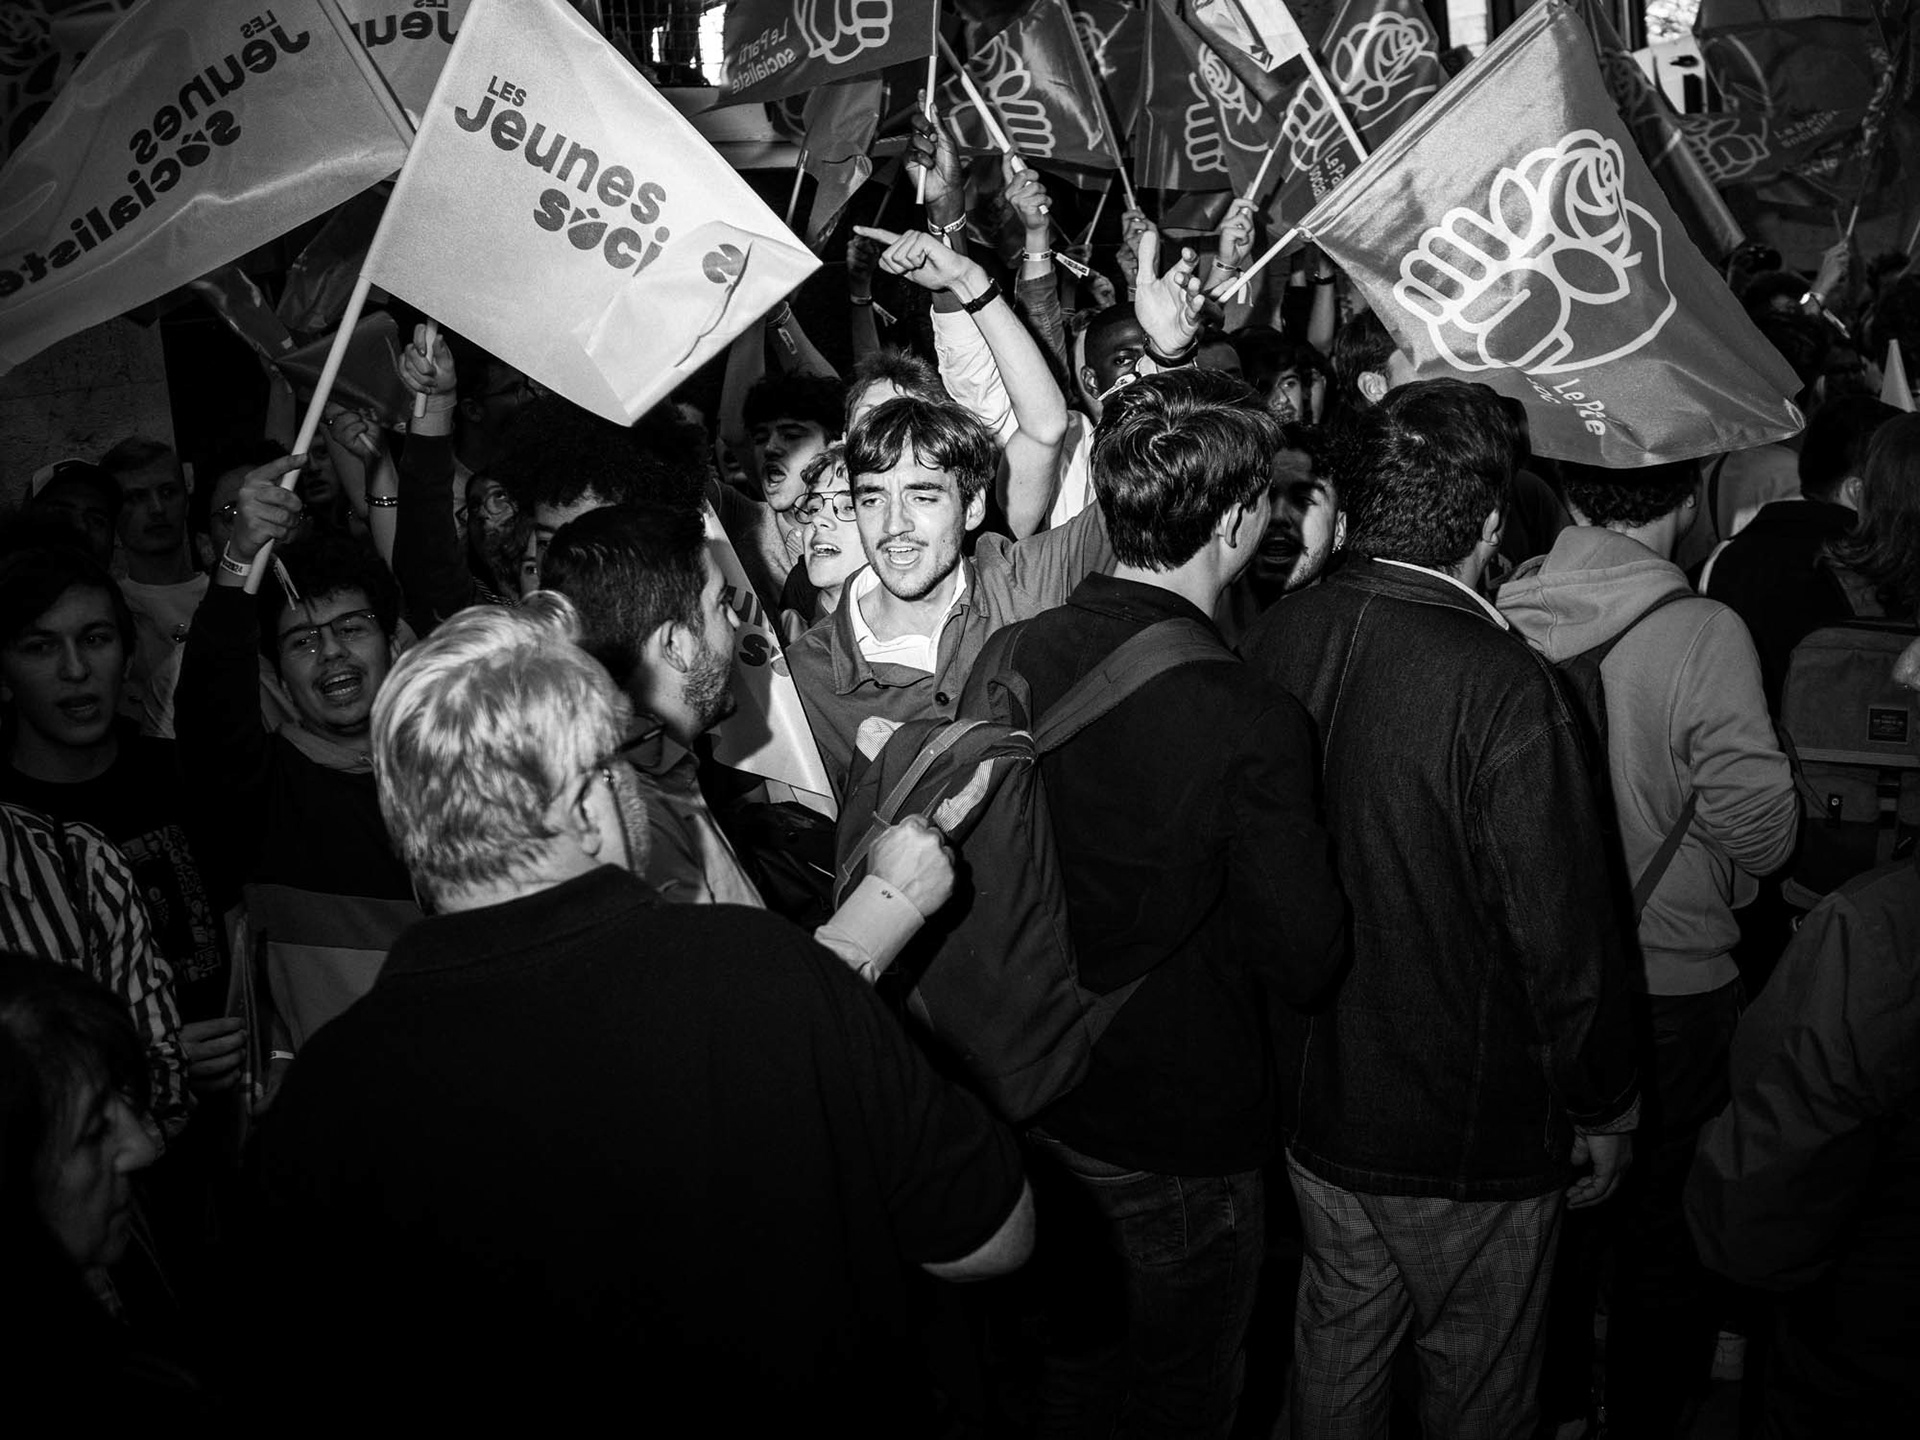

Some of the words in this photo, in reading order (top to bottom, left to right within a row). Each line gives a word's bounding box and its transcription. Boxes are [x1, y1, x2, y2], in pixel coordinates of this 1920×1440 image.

[487, 75, 527, 107] LES
[454, 96, 666, 224] Jeunes
[1552, 378, 1585, 400] Le
